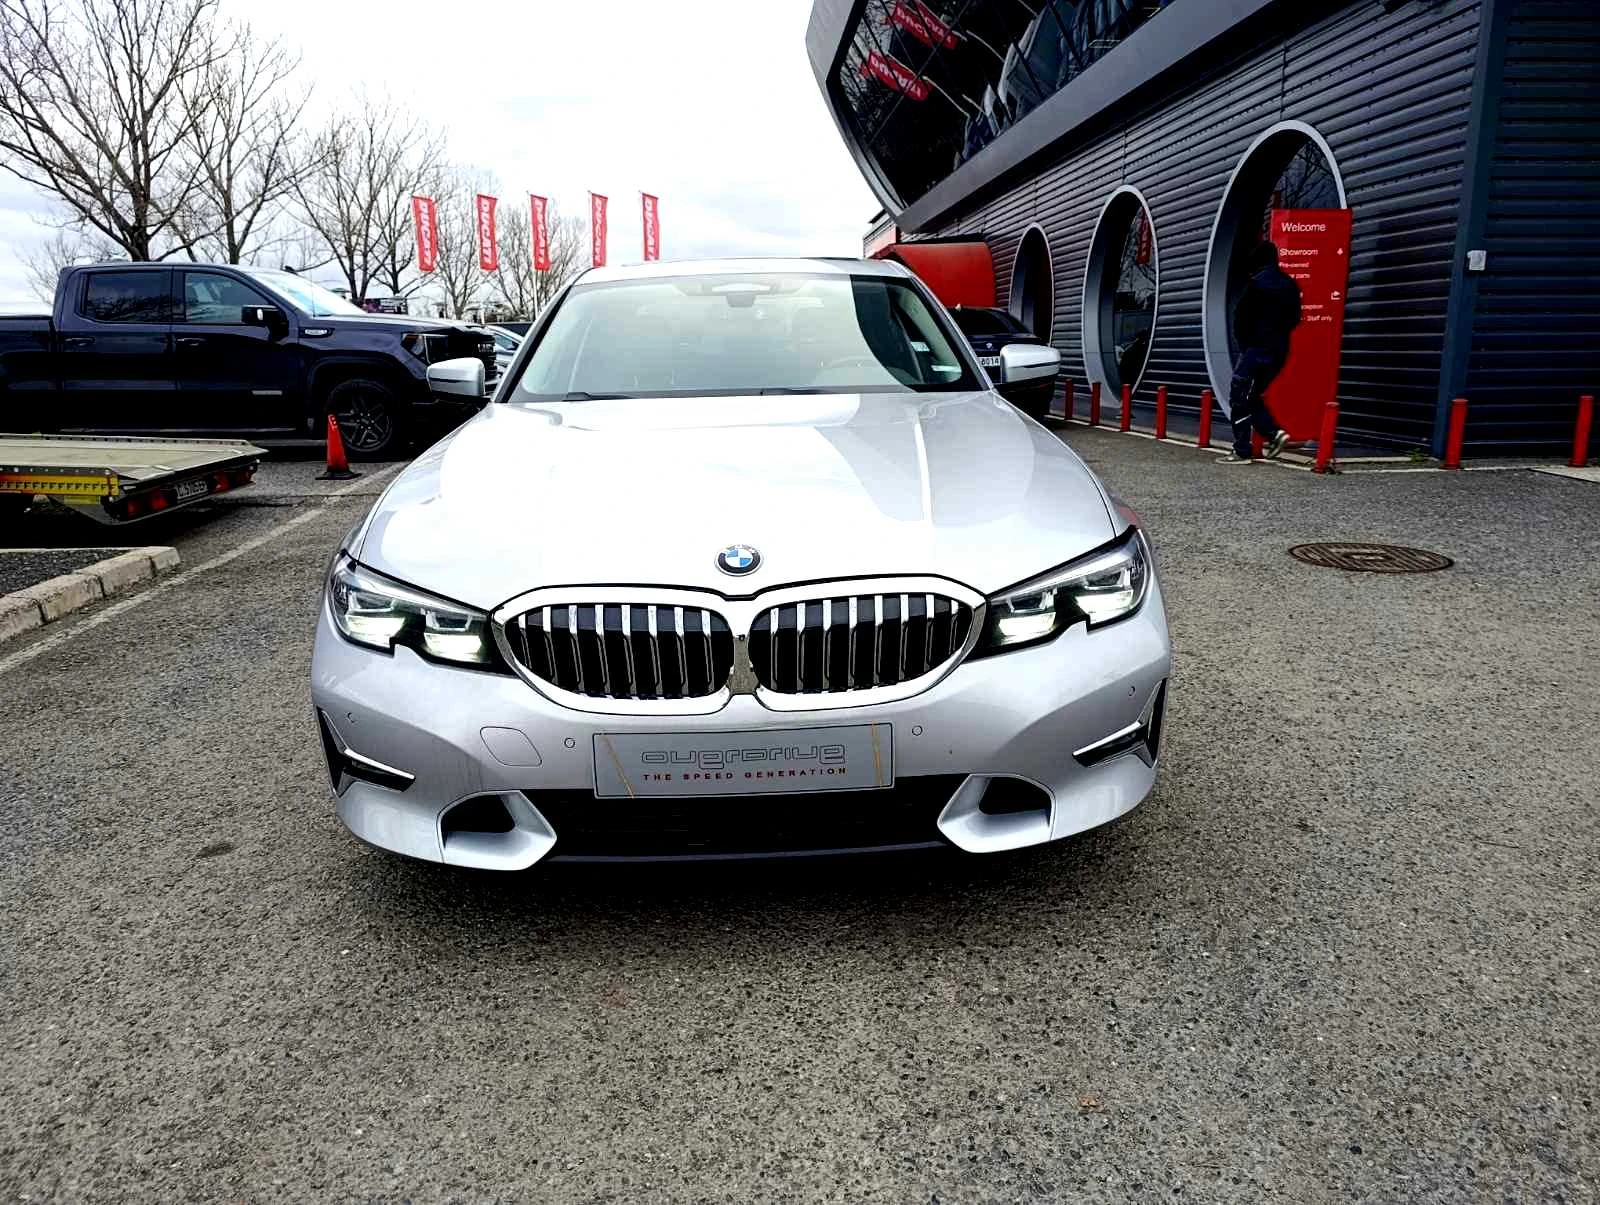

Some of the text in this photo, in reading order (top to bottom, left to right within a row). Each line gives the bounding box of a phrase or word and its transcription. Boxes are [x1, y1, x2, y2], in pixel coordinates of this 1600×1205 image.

[418, 198, 432, 265] DUCATI
[480, 198, 492, 265] DUCATI
[534, 199, 546, 264] DUCATI
[645, 198, 657, 260] DUCATI
[1281, 222, 1326, 232] Welcome
[1279, 248, 1319, 256] Showroom
[1321, 315, 1333, 323] only
[643, 767, 847, 781] THE SPEED GENERATION
